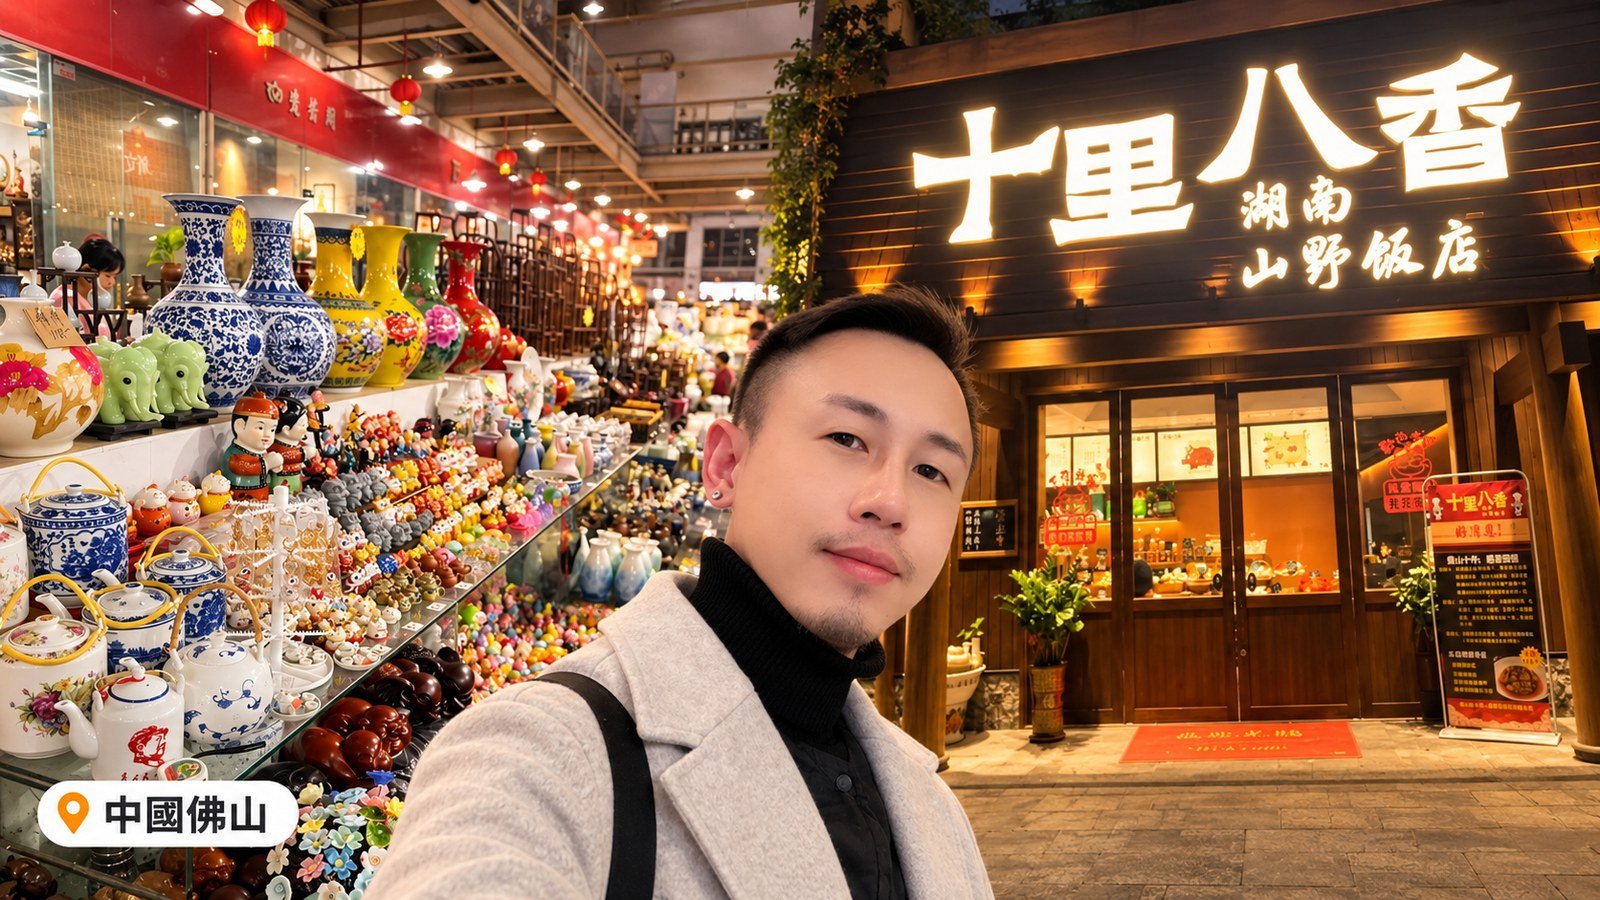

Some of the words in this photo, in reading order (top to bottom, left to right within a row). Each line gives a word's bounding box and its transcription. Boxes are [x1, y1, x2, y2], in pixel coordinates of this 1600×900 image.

[912, 52, 1522, 247] 十里八香
[1240, 175, 1352, 227] 湖南
[1242, 218, 1480, 290] 山野饭店
[1445, 490, 1508, 512] 十里八香
